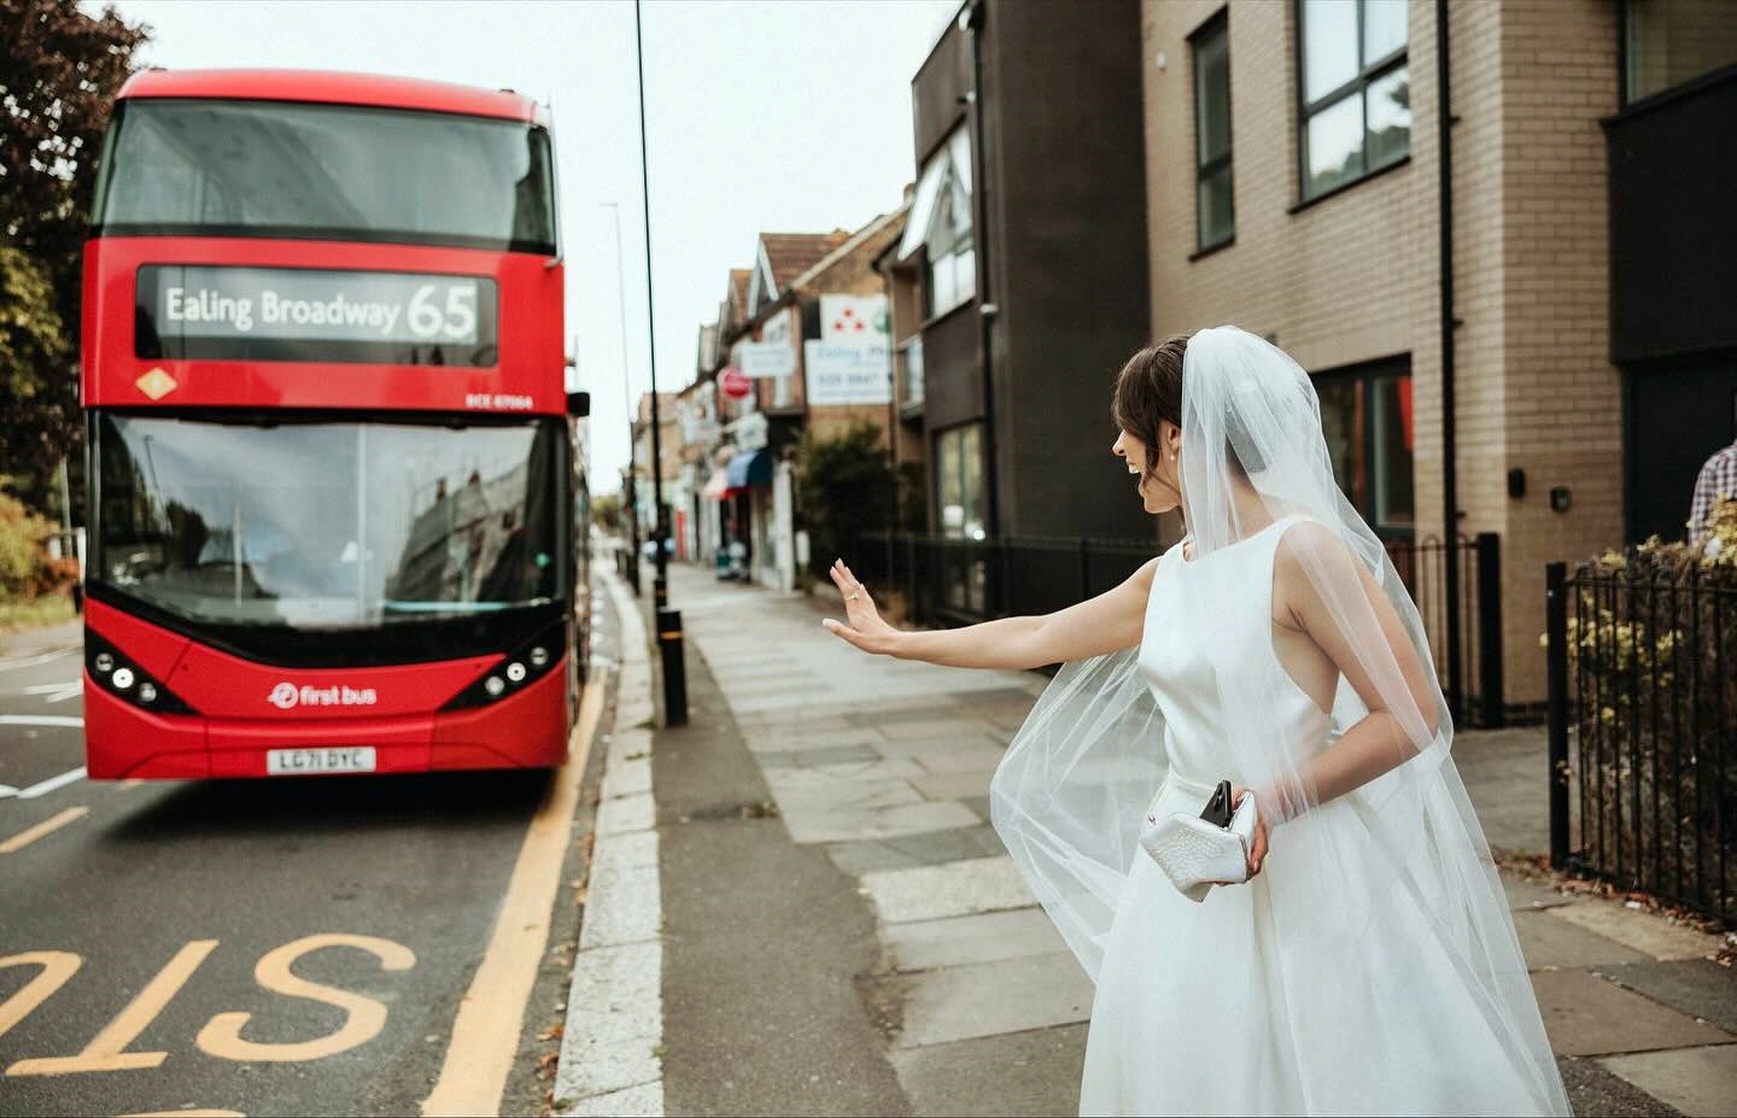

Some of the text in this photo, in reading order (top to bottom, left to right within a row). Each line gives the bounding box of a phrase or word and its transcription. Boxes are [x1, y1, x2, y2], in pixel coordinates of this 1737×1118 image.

[166, 284, 476, 339] Ealing Broadway 65
[300, 685, 377, 706] first bus
